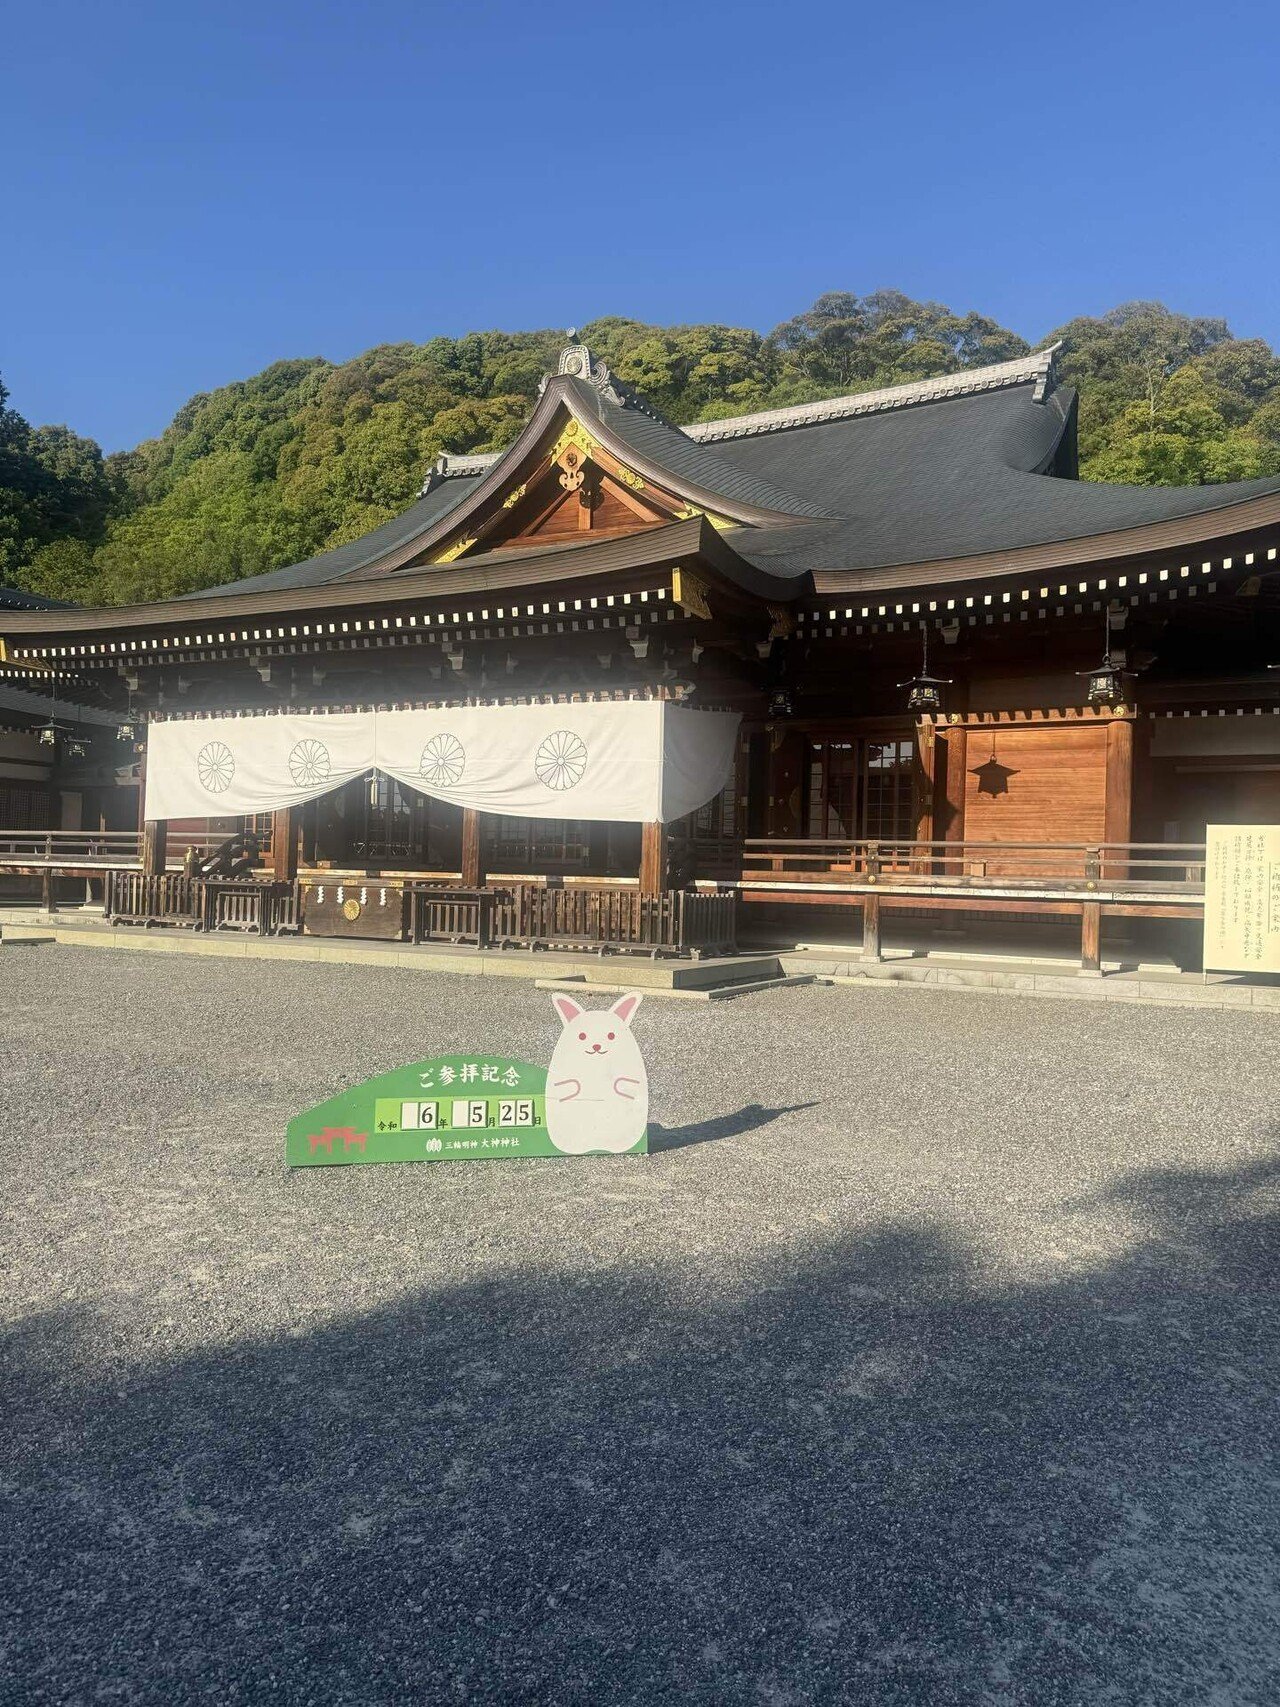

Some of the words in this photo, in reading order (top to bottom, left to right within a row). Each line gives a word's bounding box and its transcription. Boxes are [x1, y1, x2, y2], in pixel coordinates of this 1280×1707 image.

[419, 1063, 521, 1088] ご参拝記念
[481, 1137, 520, 1148] 大神神社
